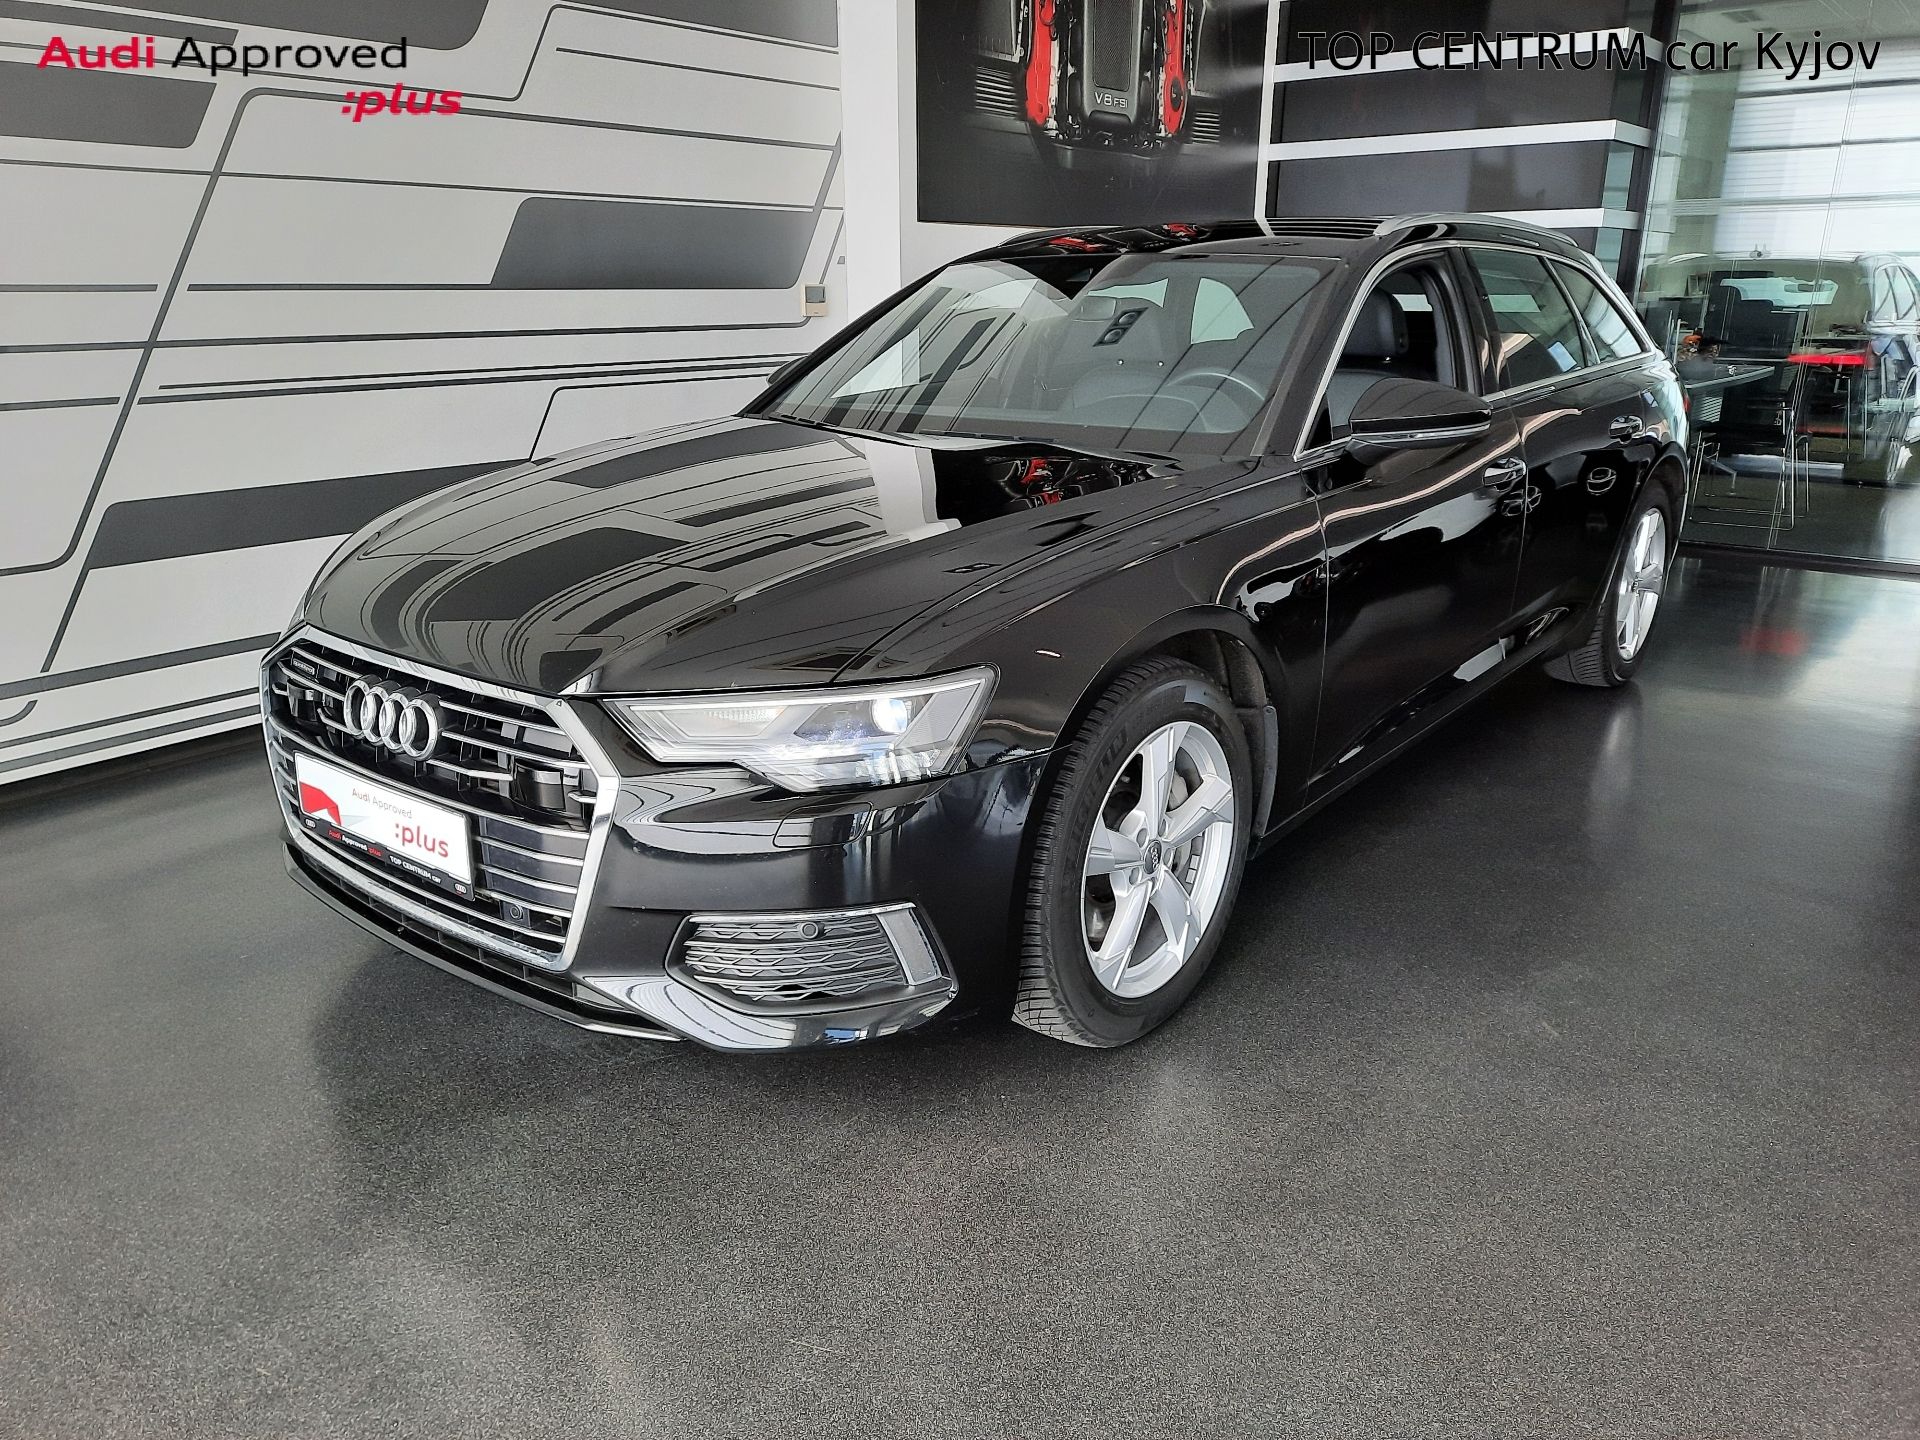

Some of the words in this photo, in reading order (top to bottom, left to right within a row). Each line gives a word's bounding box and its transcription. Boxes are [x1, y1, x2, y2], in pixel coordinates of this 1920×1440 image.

[1094, 91, 1112, 106] V8
[1113, 97, 1128, 108] FSI
[352, 788, 370, 804] Audi
[372, 795, 413, 819] Approved
[395, 823, 449, 858] :plus
[389, 855, 402, 866] TOP
